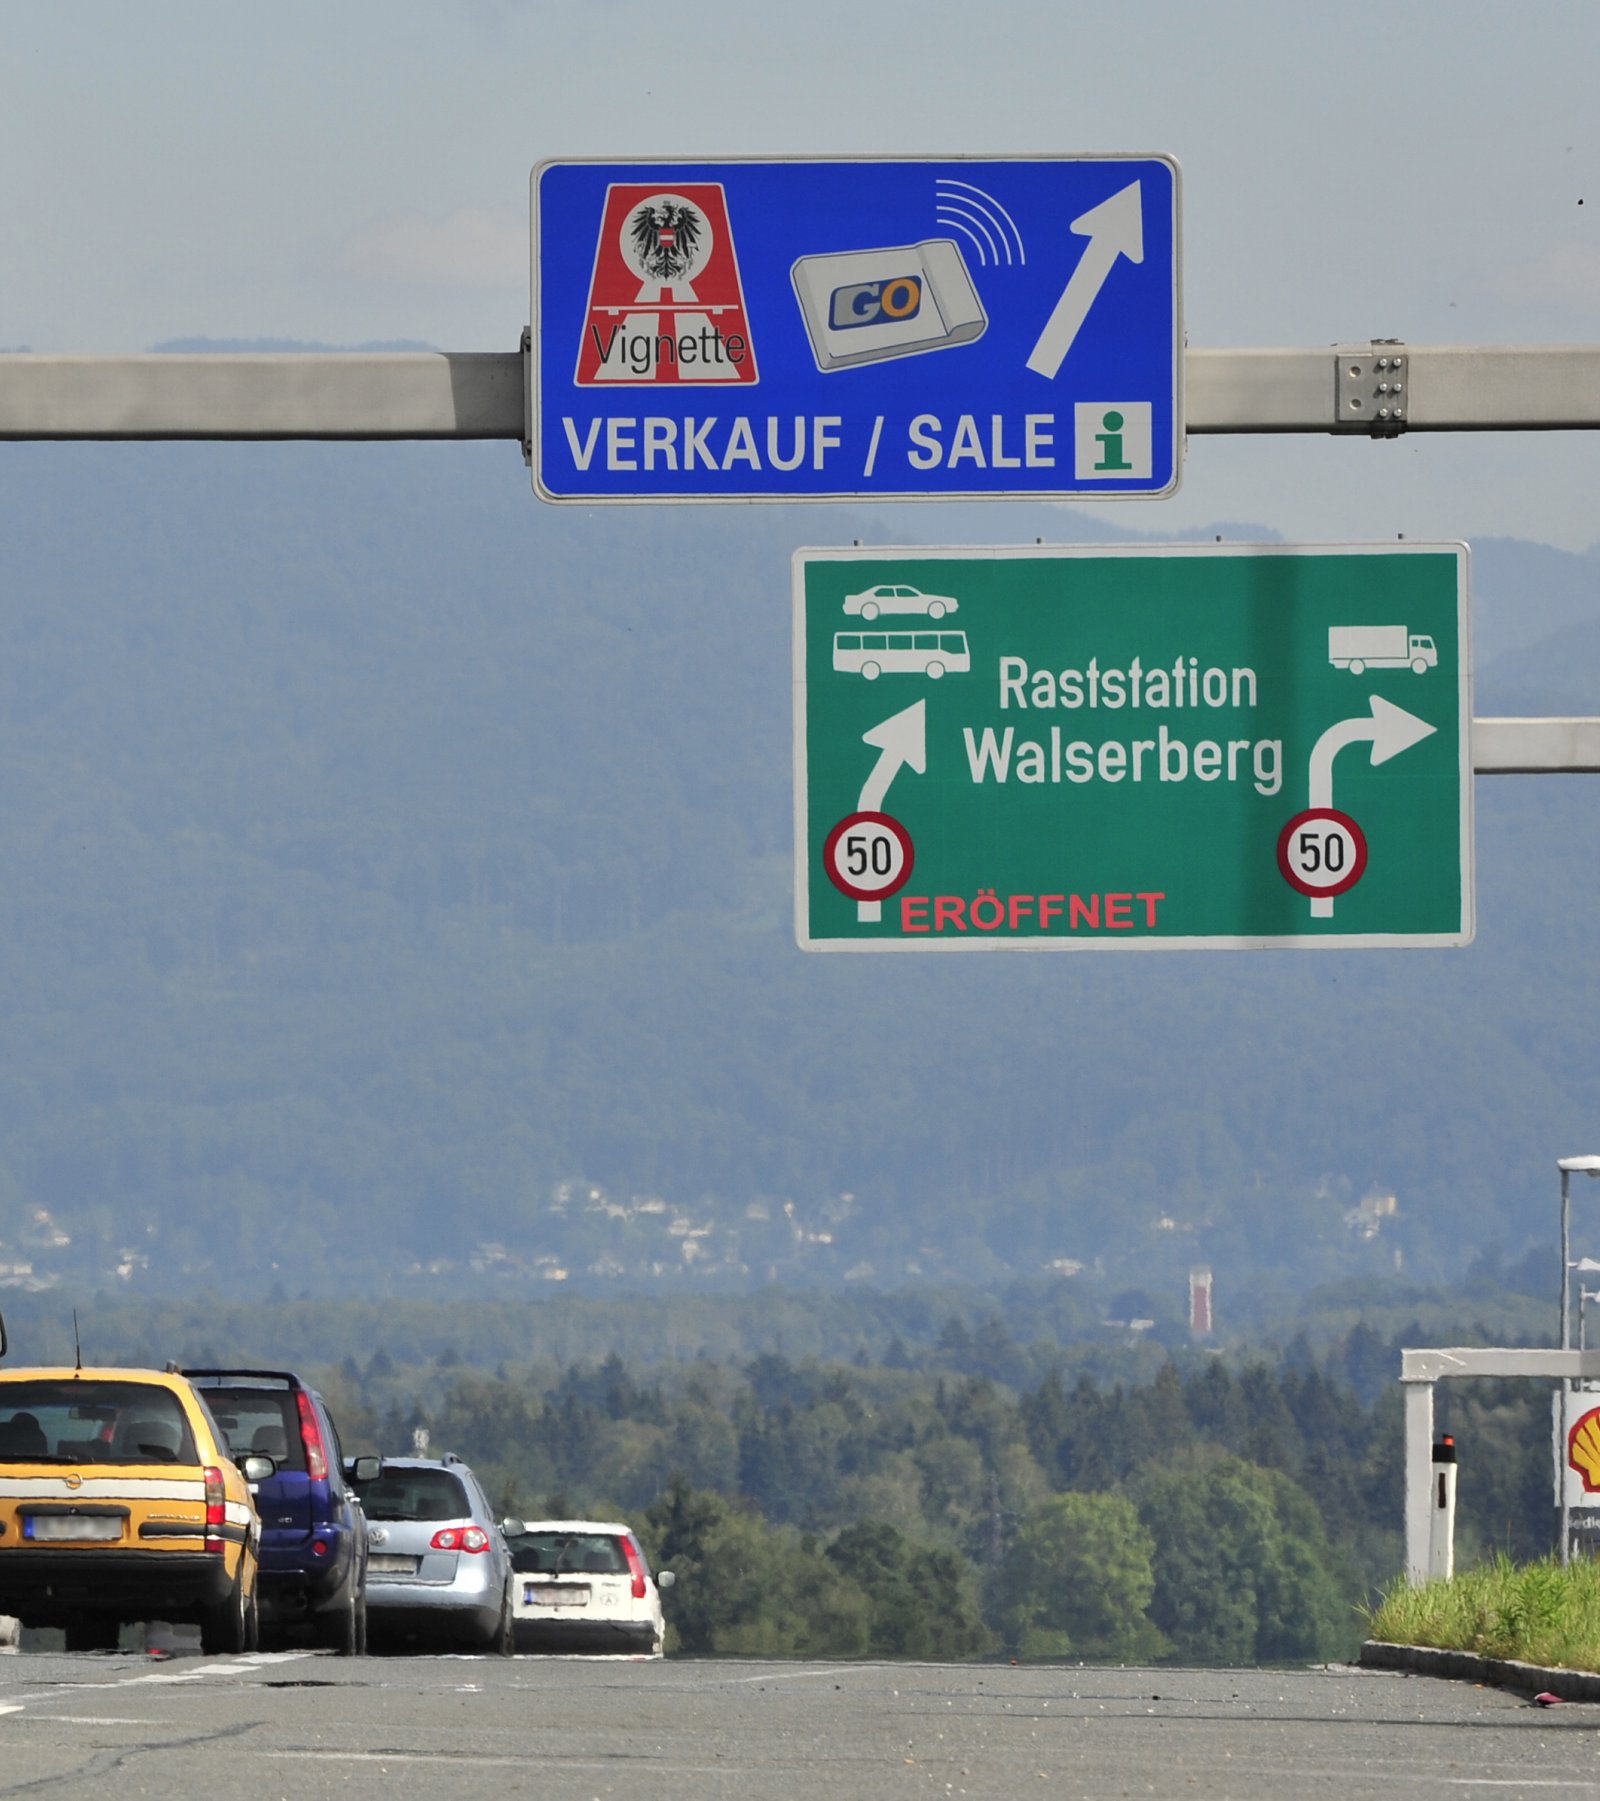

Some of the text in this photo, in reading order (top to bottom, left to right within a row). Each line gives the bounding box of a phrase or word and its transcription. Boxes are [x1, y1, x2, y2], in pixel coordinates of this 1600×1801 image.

[833, 278, 920, 326] GO
[591, 324, 746, 374] Vignette
[562, 416, 842, 471] VERKAUF
[907, 413, 1056, 470] SALE
[999, 655, 1257, 709] Raststation
[963, 725, 1282, 796] Walserberg
[846, 836, 893, 877] 50
[1299, 833, 1345, 873] 50
[900, 888, 1165, 932] ERÖFFNET
